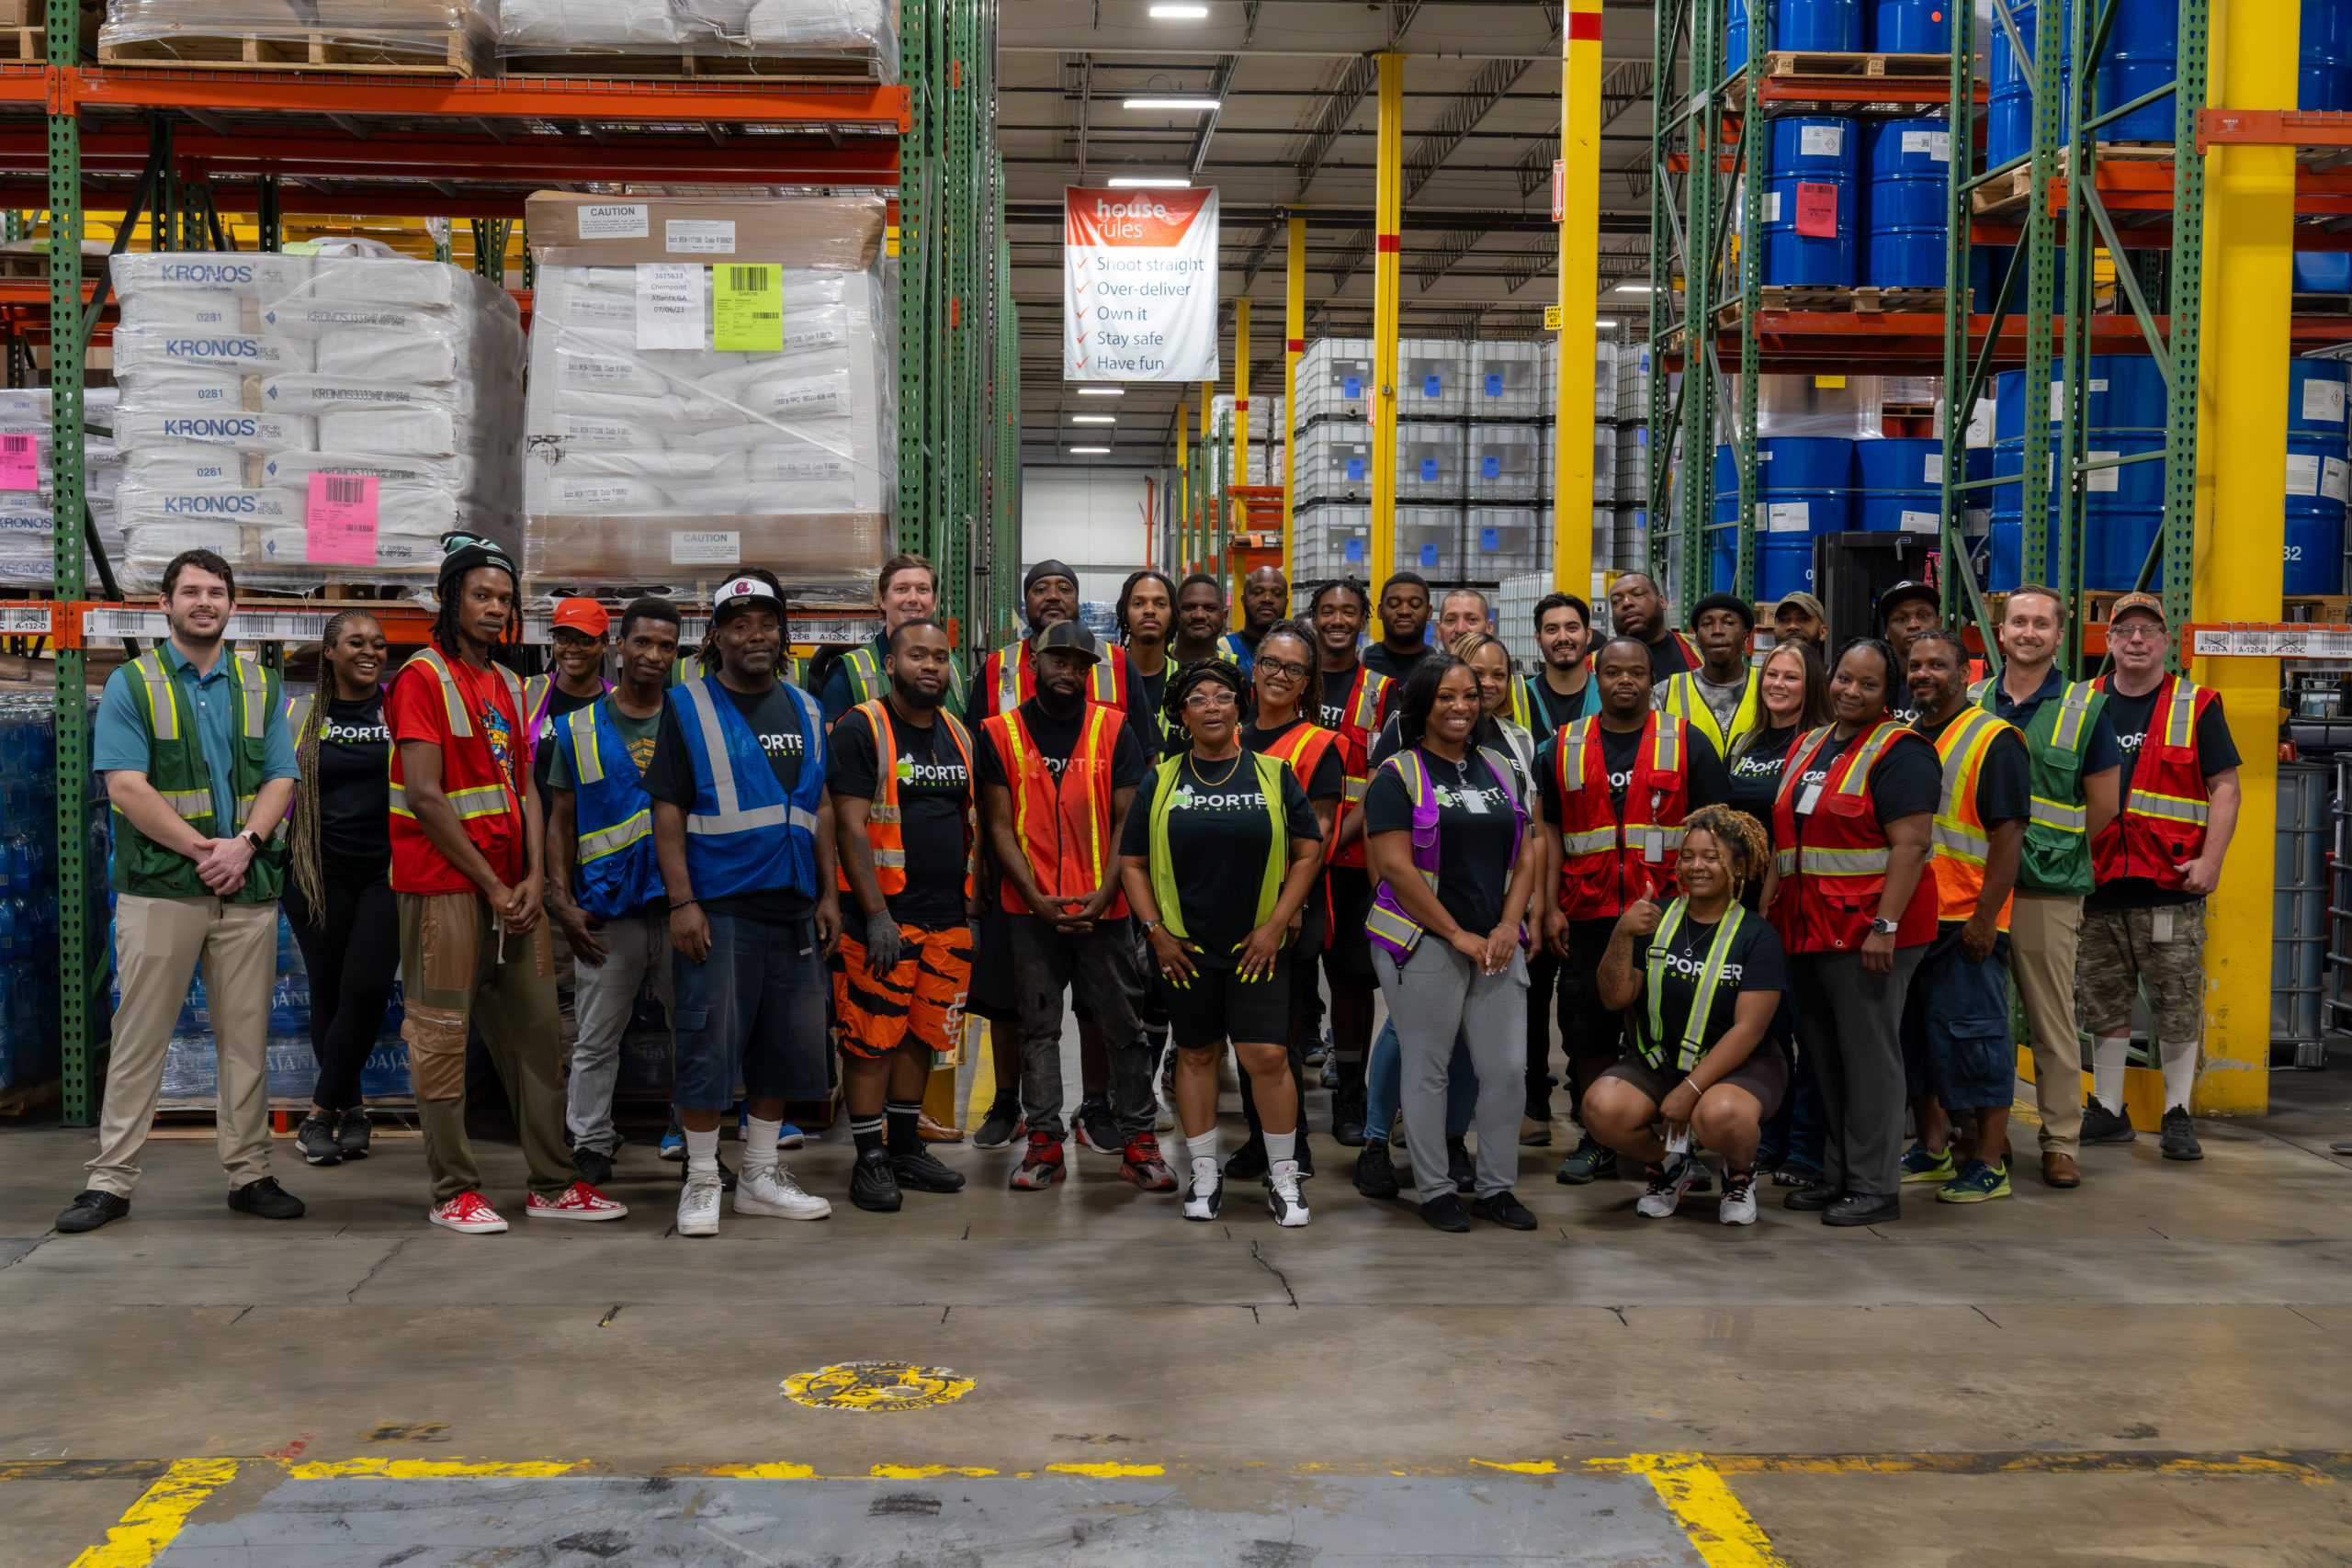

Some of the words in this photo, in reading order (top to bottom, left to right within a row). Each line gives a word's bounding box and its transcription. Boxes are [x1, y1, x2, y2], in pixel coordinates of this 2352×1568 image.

[590, 207, 636, 217] CAUTION
[1097, 198, 1167, 219] house
[1097, 218, 1143, 238] rules
[1097, 256, 1142, 272] Shoot
[1147, 257, 1204, 275] straight
[162, 265, 253, 283] KRONOS
[650, 284, 687, 292] Chempoint
[1097, 281, 1192, 296] Over-deliver
[651, 295, 687, 303] Atlanta,GA
[197, 313, 222, 322] 0281
[1097, 306, 1134, 321] Own
[1137, 307, 1148, 321] it
[1097, 331, 1129, 348] Stay
[1133, 331, 1163, 345] safe
[166, 340, 257, 356] KRONOS
[1097, 355, 1136, 370] Have
[1138, 355, 1165, 370] fun
[198, 389, 223, 399] 0281
[164, 419, 255, 436] KRONOS
[197, 467, 222, 477] 0281
[164, 496, 255, 513] KRONOS
[683, 534, 728, 542] CAUTION
[330, 726, 390, 739] PORTE
[759, 734, 803, 750] ORTE
[914, 764, 967, 780] PORTE
[1742, 759, 1785, 773] PORT
[1194, 793, 1267, 807] PORTE
[1664, 953, 1744, 981] PORER
[266, 1055, 321, 1074] ASANI
